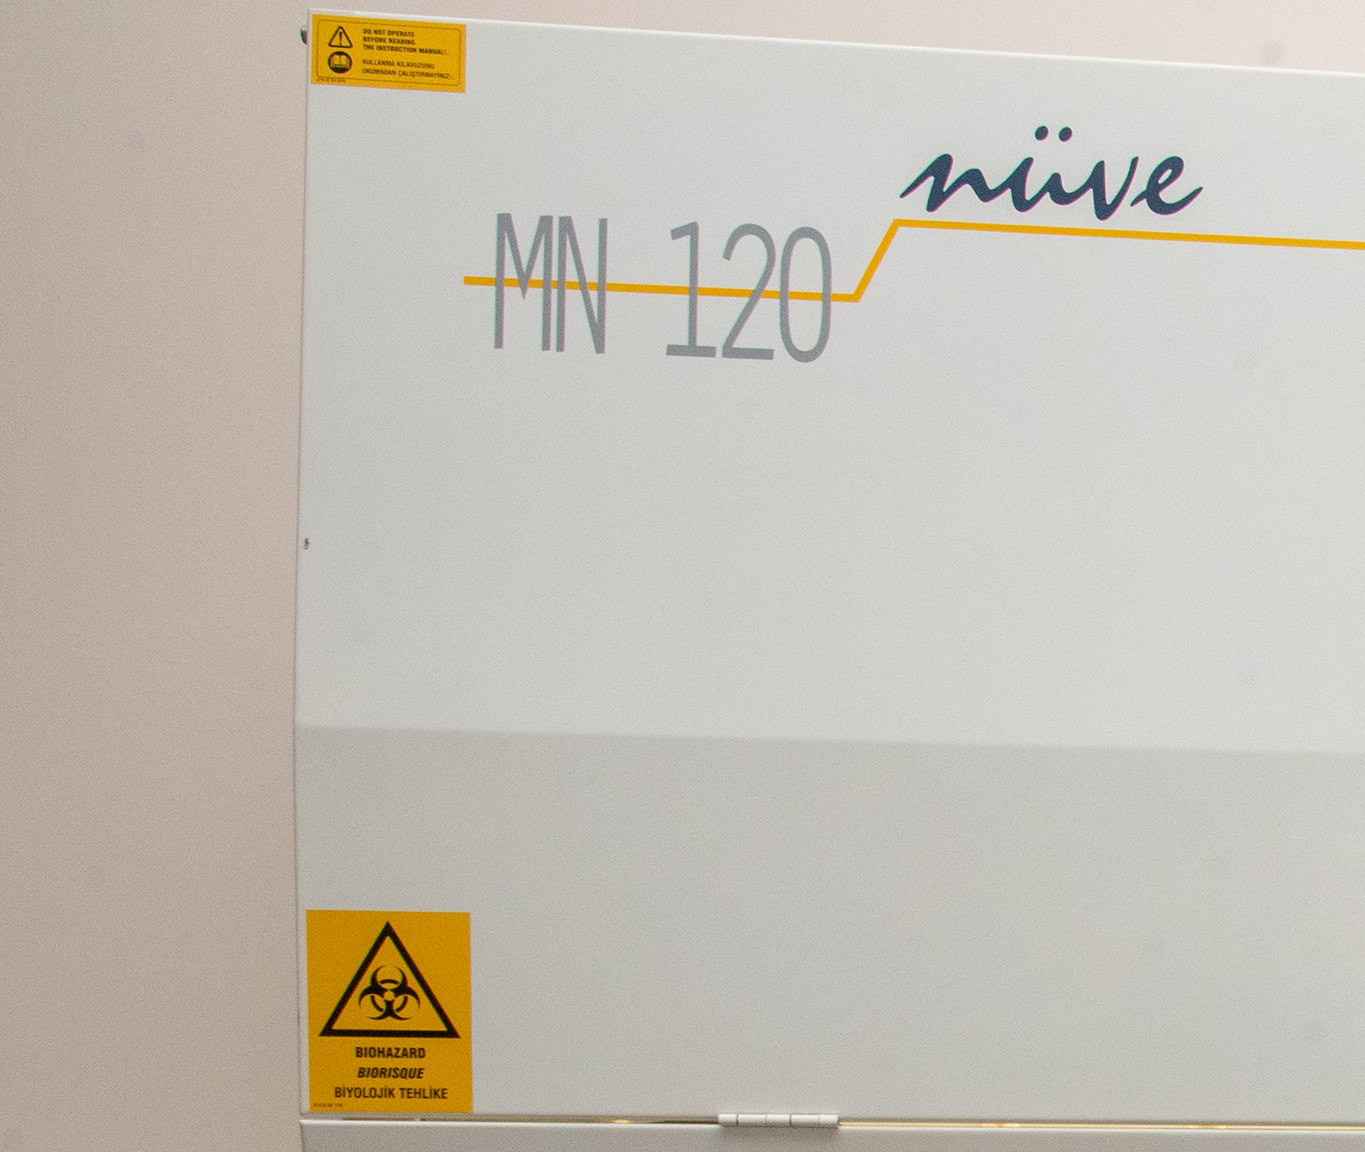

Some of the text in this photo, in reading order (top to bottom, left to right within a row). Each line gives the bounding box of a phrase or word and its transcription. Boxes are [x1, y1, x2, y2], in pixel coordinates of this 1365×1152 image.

[900, 126, 1204, 221] nüve
[493, 212, 832, 362] MN 120
[355, 1046, 426, 1059] BIOHAZARD
[358, 1067, 425, 1079] BIORISQUE
[334, 1085, 448, 1100] BİYOLOJİK TEHLİKE
